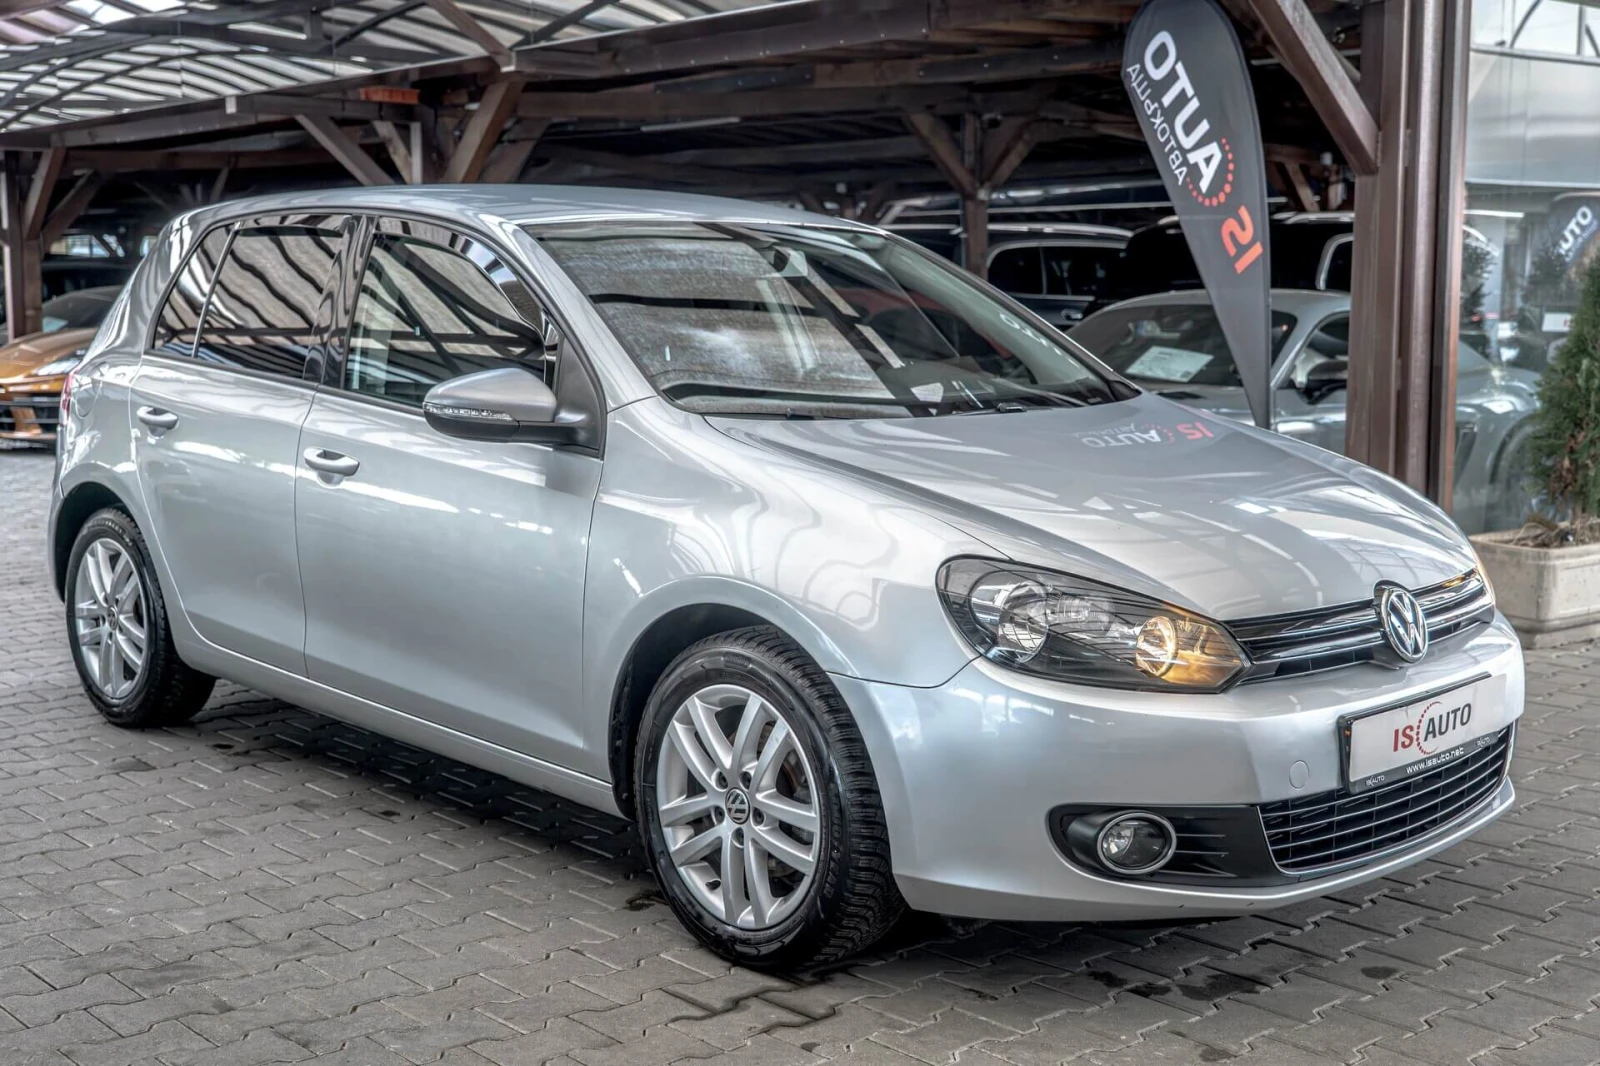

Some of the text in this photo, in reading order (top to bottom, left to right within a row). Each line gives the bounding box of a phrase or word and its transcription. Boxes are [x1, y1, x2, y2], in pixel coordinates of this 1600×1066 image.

[1081, 429, 1161, 448] AUTO
[1393, 703, 1472, 753] IS AUTO
[1406, 746, 1465, 774] www.isauto.net
